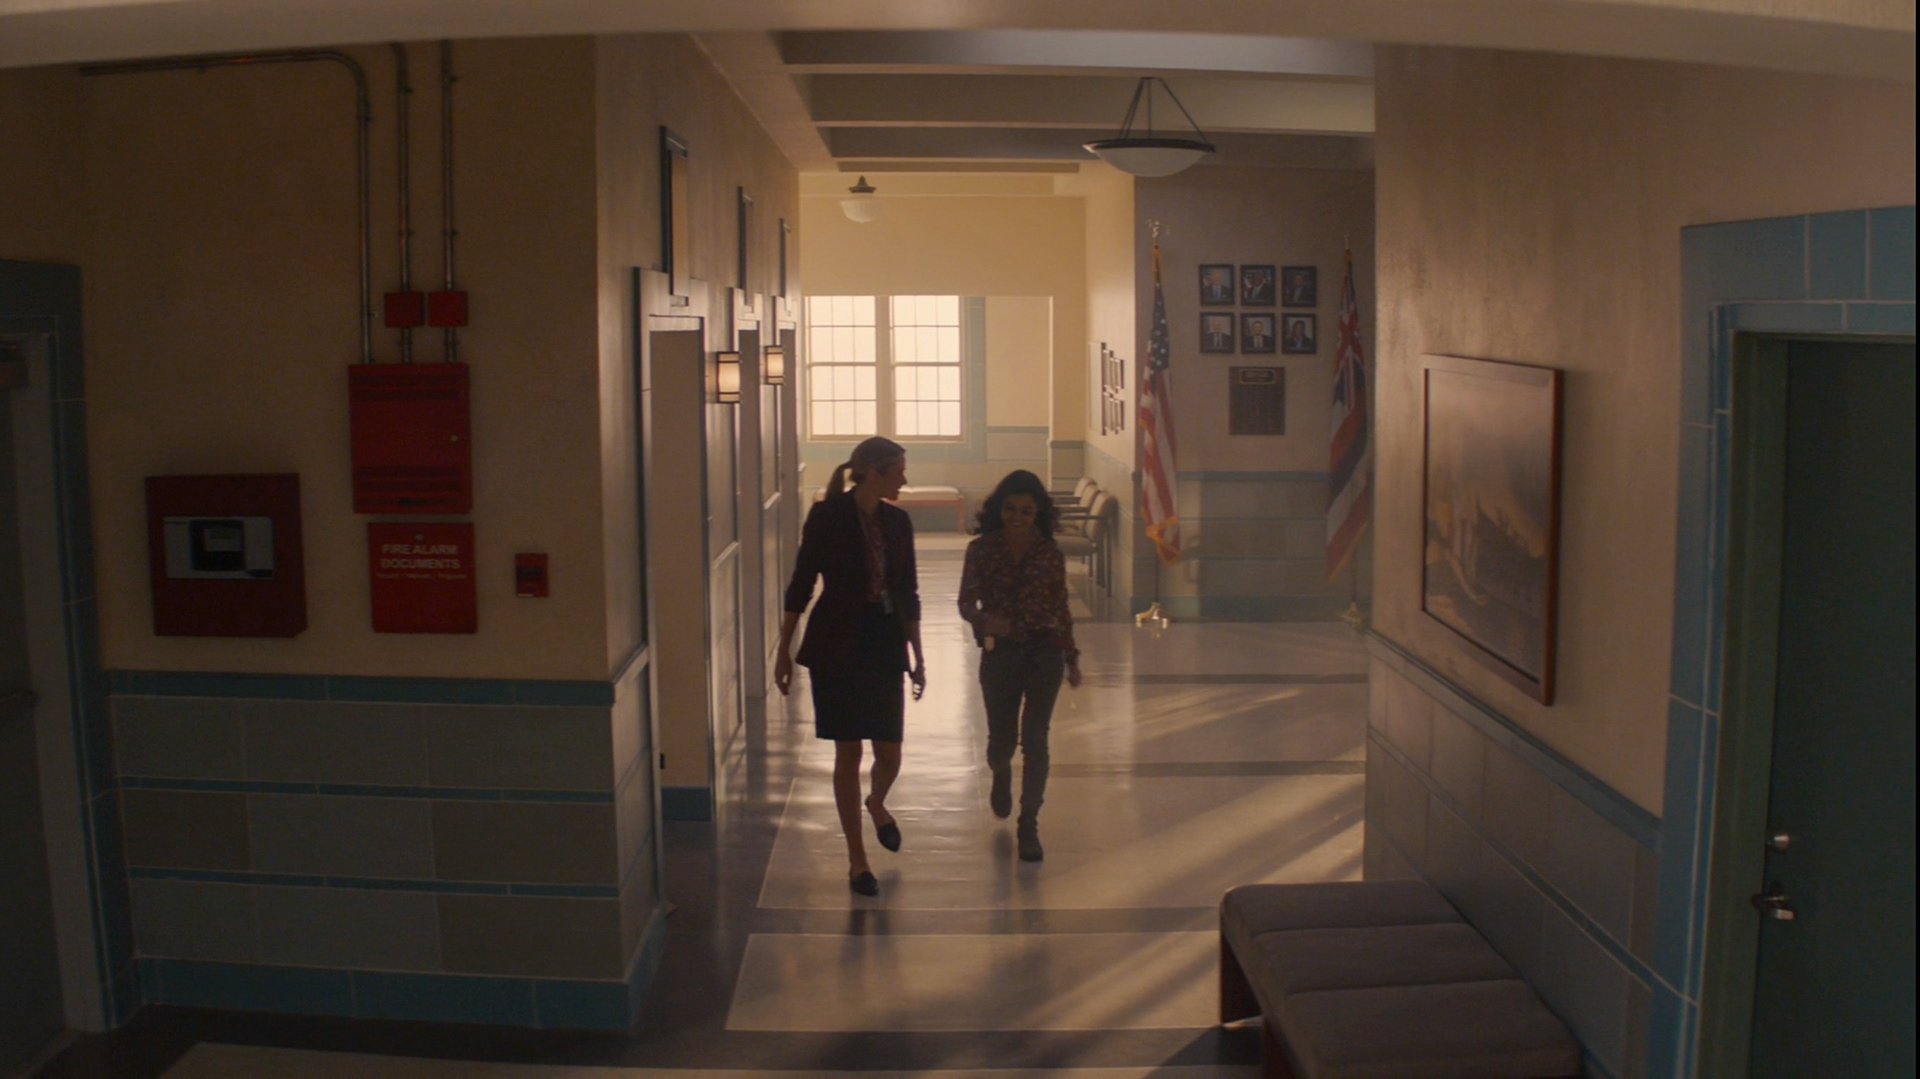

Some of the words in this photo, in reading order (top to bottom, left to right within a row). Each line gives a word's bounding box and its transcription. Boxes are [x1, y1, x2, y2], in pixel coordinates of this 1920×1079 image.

[382, 544, 411, 554] FIRE
[413, 544, 458, 554] ALARM
[381, 558, 460, 569] DOCUMENTS
